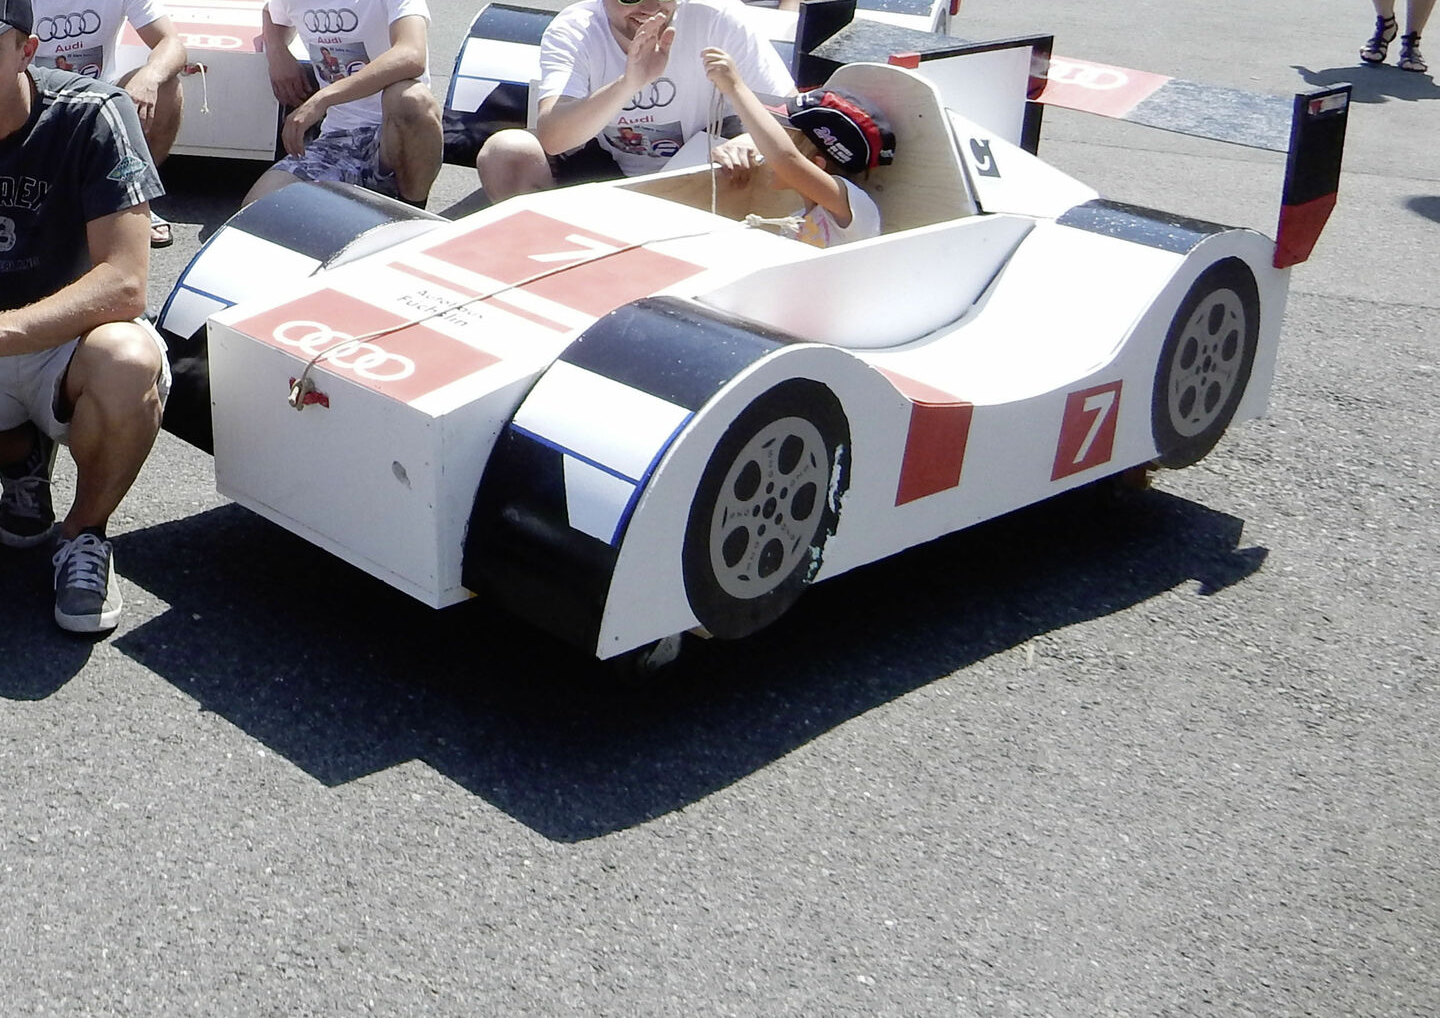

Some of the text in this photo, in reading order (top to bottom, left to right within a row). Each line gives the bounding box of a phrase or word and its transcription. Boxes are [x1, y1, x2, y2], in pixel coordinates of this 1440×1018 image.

[317, 36, 342, 44] Audi
[55, 41, 83, 53] Audi
[617, 115, 654, 125] Audi
[527, 233, 621, 263] 7
[1072, 390, 1116, 464] 7
